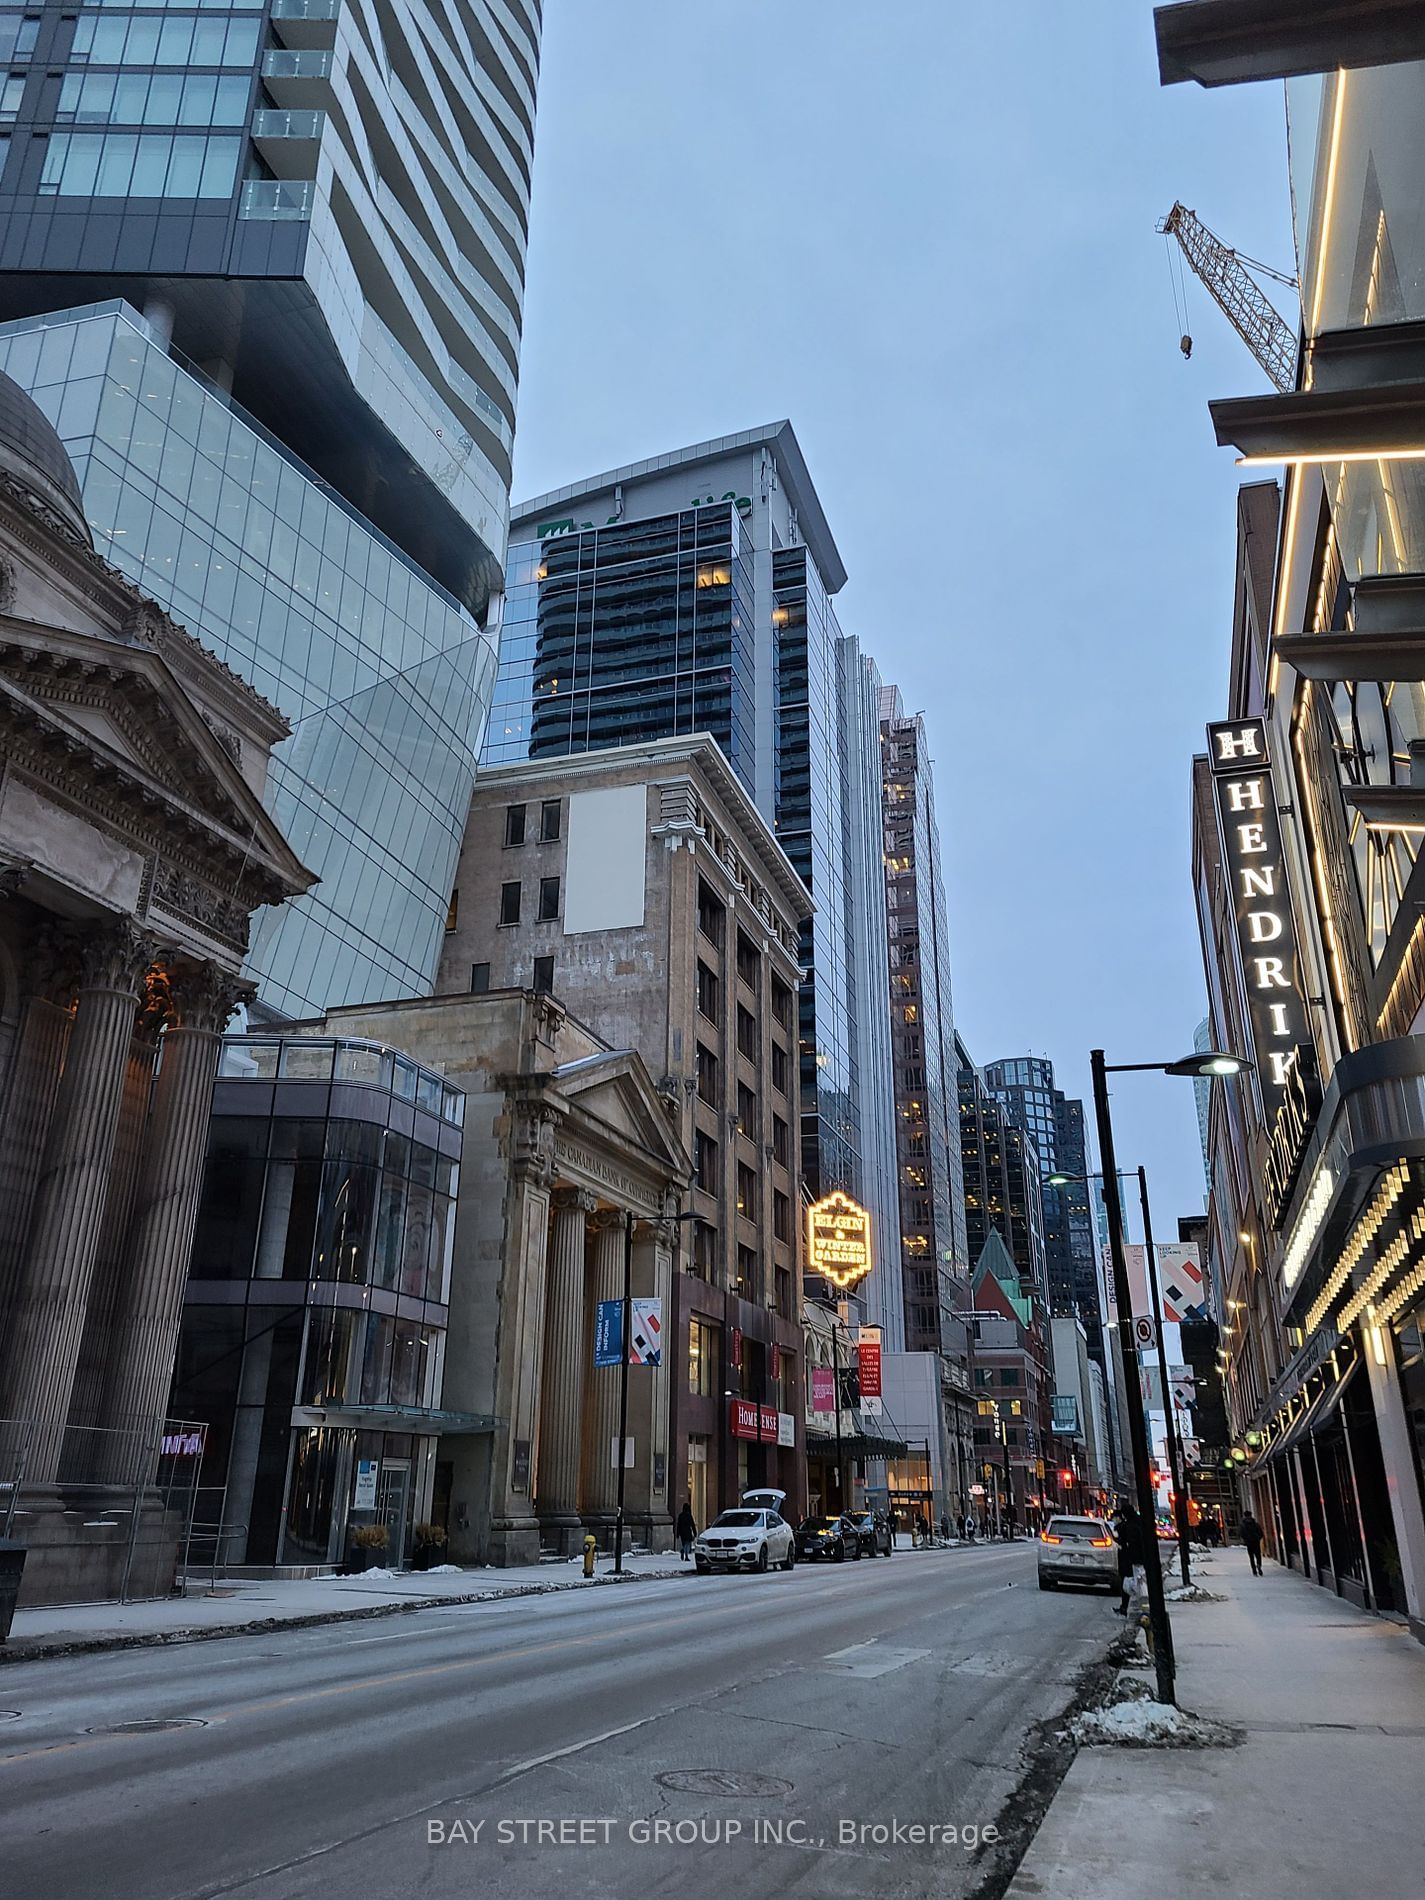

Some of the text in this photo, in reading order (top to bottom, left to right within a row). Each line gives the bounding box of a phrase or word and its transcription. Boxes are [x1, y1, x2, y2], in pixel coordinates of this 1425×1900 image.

[1216, 727, 1261, 761] H
[814, 1214, 864, 1231] ELGIN
[815, 1238, 866, 1253] WINTER
[814, 1250, 866, 1264] GARDEN
[595, 1322, 603, 1352] DESIGN
[738, 1406, 777, 1431] HOMEENSE
